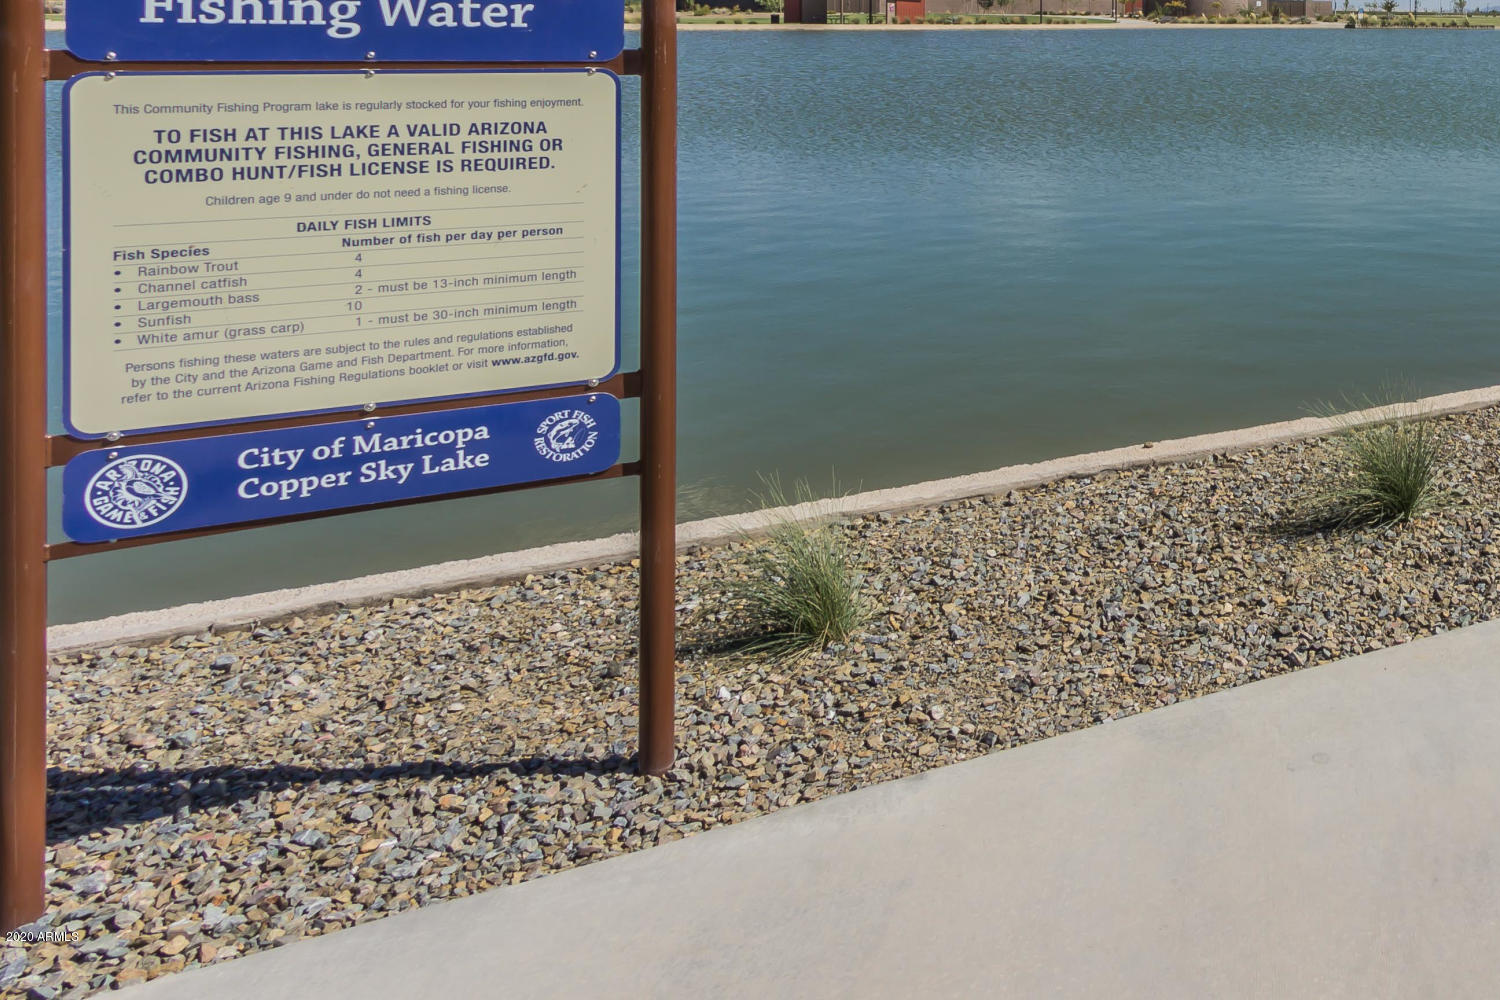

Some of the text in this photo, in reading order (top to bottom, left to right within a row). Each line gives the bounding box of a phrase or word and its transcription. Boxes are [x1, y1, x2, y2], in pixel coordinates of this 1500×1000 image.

[112, 97, 584, 115] This Community Fishing Program lake is regularly stocked for your fishing enjoyment.
[153, 121, 548, 144] TO FISH AT THIS LAKE A VALID ARIZONA
[133, 138, 563, 165] COMMUNITY FISHING, GENERAL FISHING OR
[144, 156, 555, 185] COMBO HUNT/FISH LICENSE IS REQUIRED.
[205, 185, 511, 207] Children age 9 and under do not need a fishing license.
[296, 215, 432, 233] DAILY FISH LIMITS
[342, 227, 563, 248] Number of fish per day per person
[113, 247, 210, 262] Fish Species
[354, 252, 362, 262] 4
[138, 261, 239, 277] Rainbow Trout
[354, 268, 362, 278] 4
[138, 276, 248, 294] Channel catfish
[354, 284, 363, 295] 2
[377, 281, 409, 293] must
[413, 280, 428, 291] be
[433, 276, 479, 289] 13-inch
[483, 273, 538, 286] minimum
[541, 269, 577, 282] length
[138, 294, 260, 312] Largemouth bass
[346, 300, 363, 312] 10
[356, 317, 361, 327] 1
[378, 312, 409, 325] must
[413, 312, 428, 322] be
[432, 307, 479, 321] 30-inch
[483, 304, 538, 316] minimum
[542, 299, 577, 312] length
[137, 314, 192, 328] Sunfish
[137, 321, 305, 345] White amur (grass carp)
[125, 323, 573, 373] Persons fishing these waters are subject to the rules and regulations established
[131, 338, 568, 390] by the City and the Arizona Game and Fish Department. For more information,
[121, 351, 580, 405] refer to the current Arizona Fishing Regulations booklet or visit www.azgfd.gov.
[537, 409, 597, 434] SPORT FISH
[237, 425, 491, 471] City of Maricopa
[533, 431, 599, 462] RESTORATION
[95, 459, 177, 491] ARZONA
[237, 450, 490, 500] Copper Sky Lake
[92, 487, 181, 523] GAME & FISH
